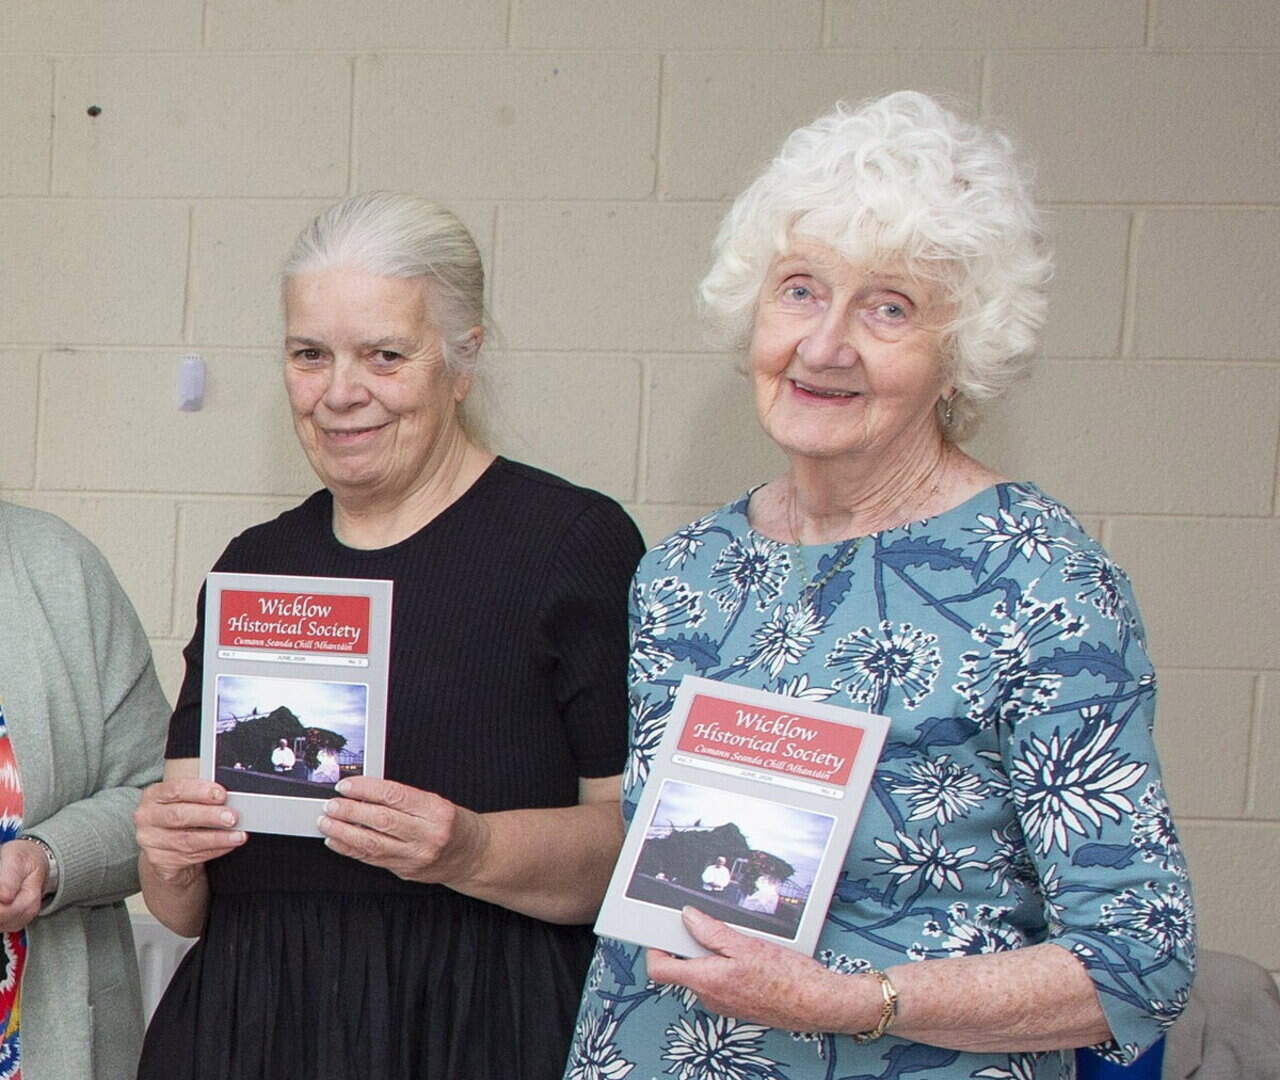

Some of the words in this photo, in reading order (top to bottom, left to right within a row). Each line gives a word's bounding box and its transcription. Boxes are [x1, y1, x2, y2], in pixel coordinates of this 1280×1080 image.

[258, 595, 332, 618] Wicklow
[227, 613, 307, 635] Historical
[306, 621, 361, 647] Society
[293, 639, 314, 649] Chill
[735, 709, 818, 742] Wicklow
[693, 721, 786, 754] Historical
[781, 742, 845, 775] Society
[694, 743, 731, 759] Cumann
[762, 759, 788, 770] Chill
